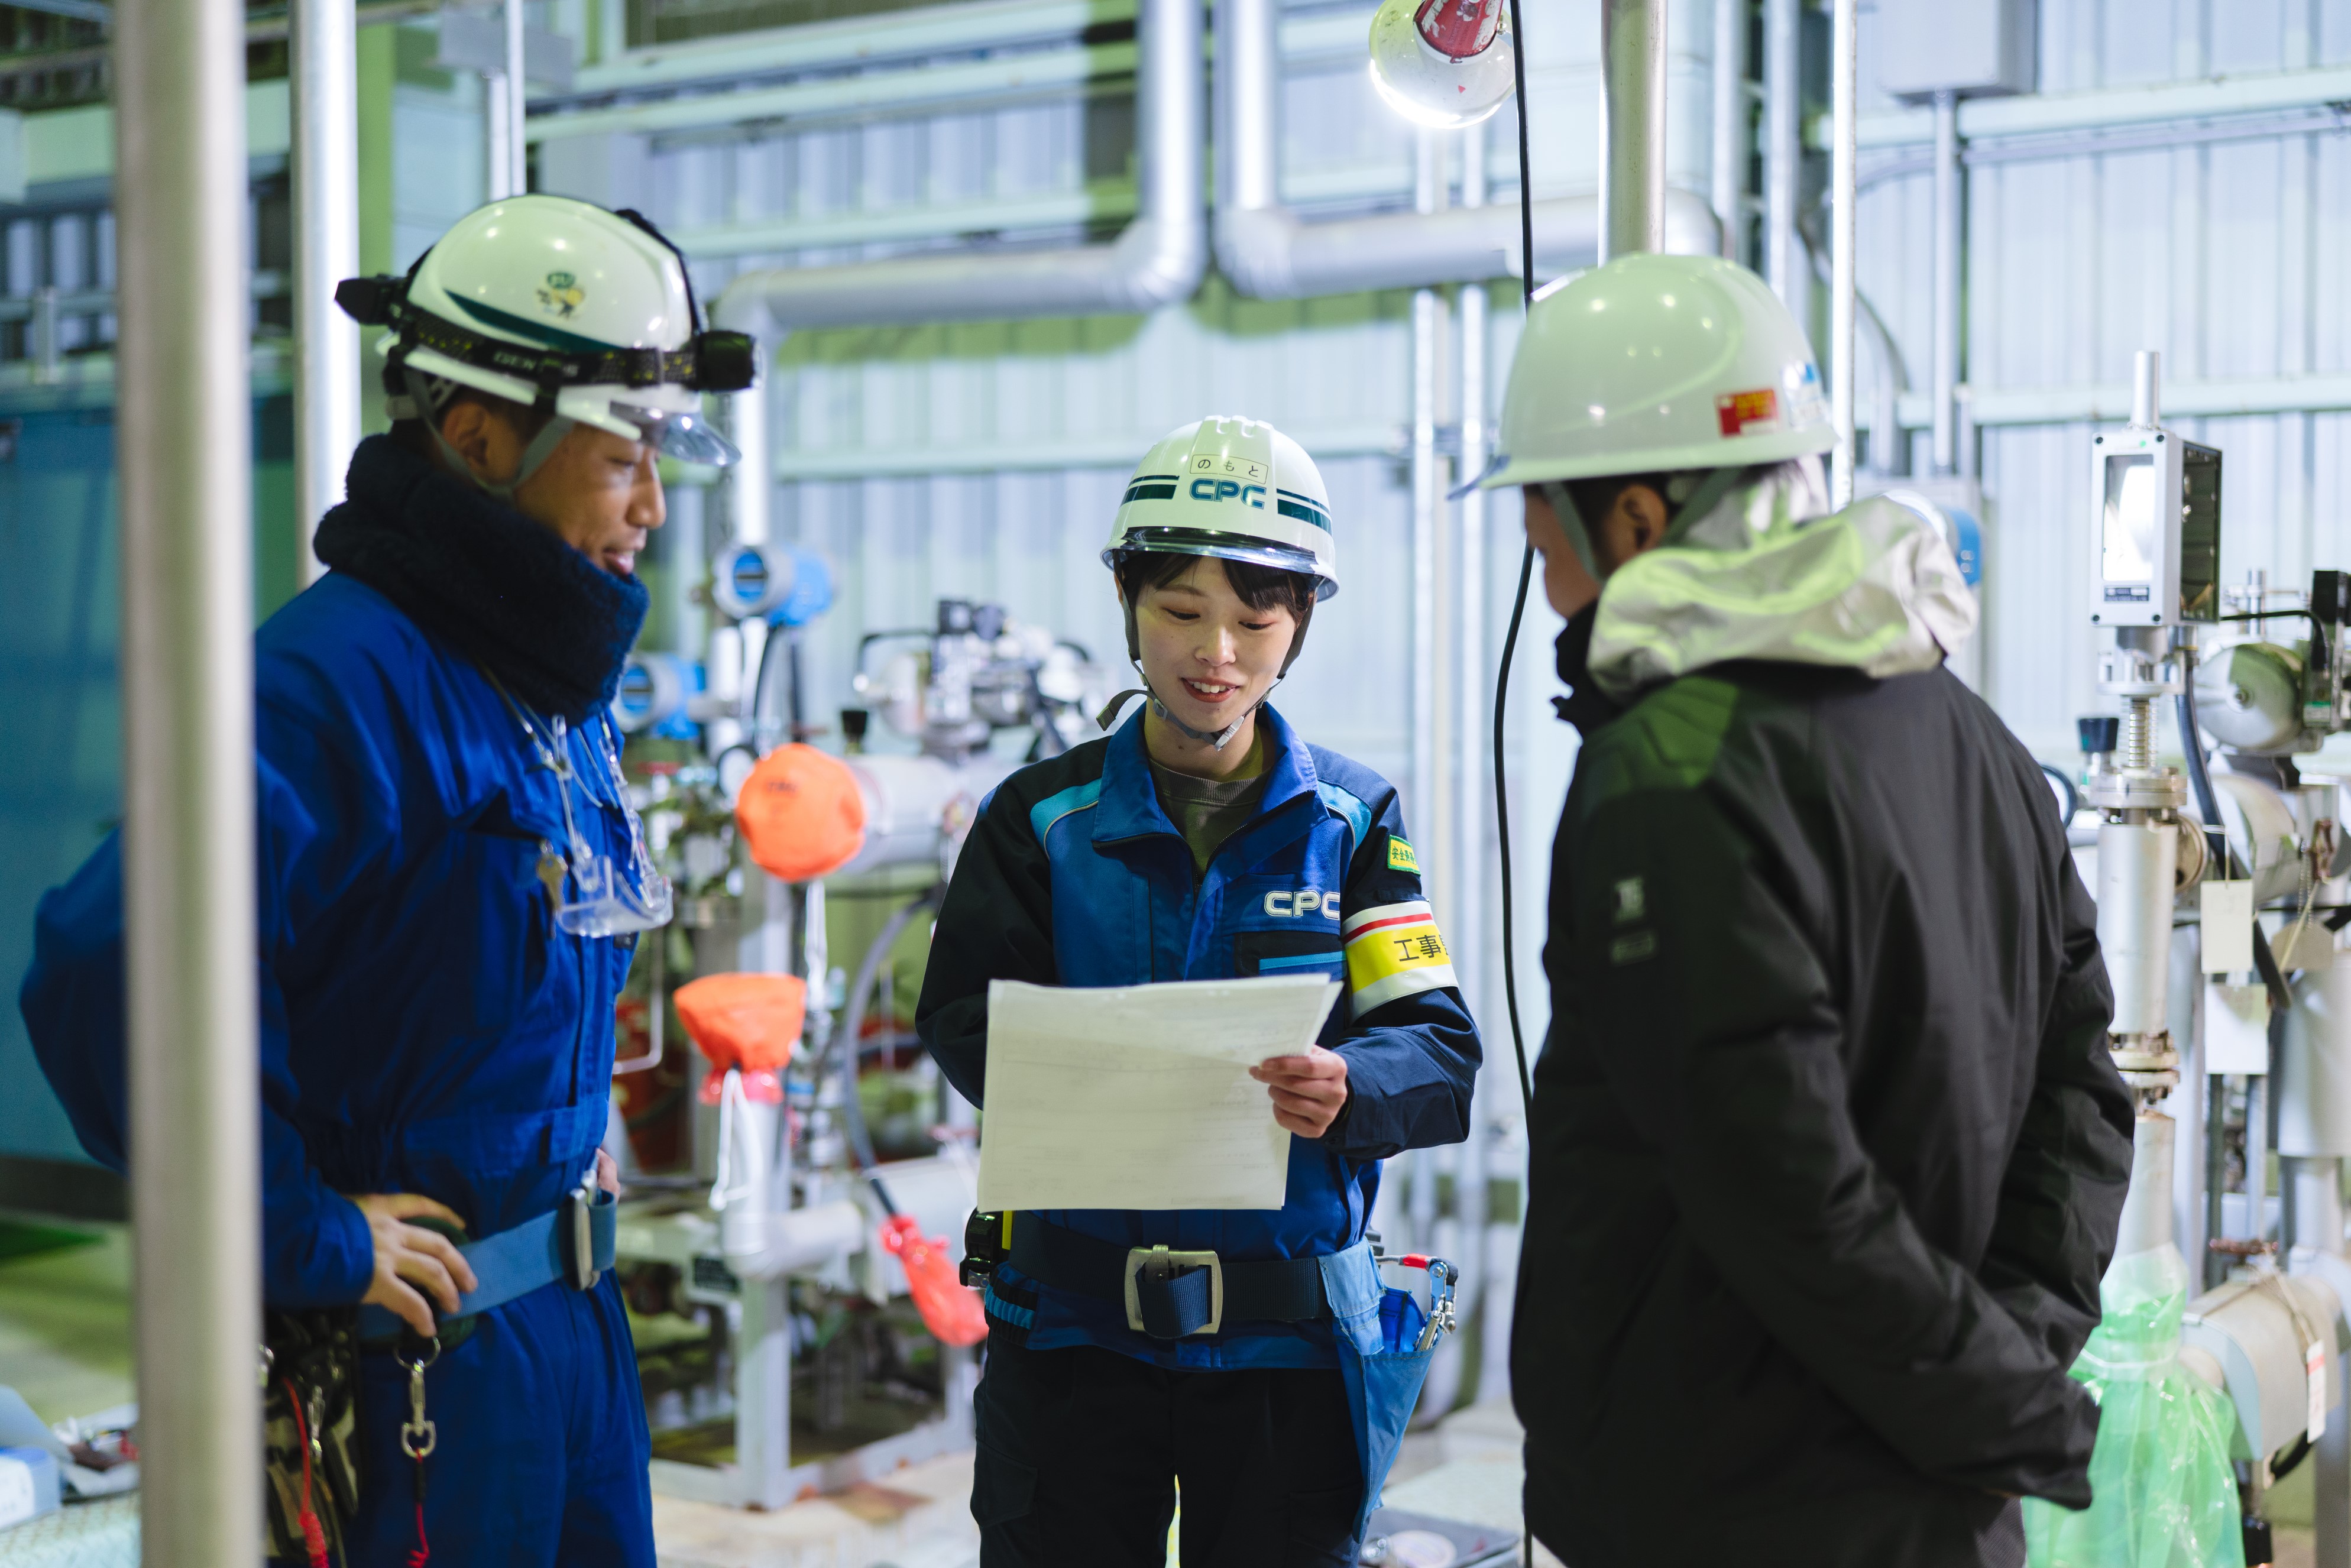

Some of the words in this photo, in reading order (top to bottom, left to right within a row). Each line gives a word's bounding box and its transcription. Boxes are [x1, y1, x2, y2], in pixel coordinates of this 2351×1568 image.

[1198, 459, 1258, 477] のもと
[1190, 478, 1267, 510] CPC
[1264, 889, 1340, 921] CPC
[1393, 934, 1448, 962] 工事
